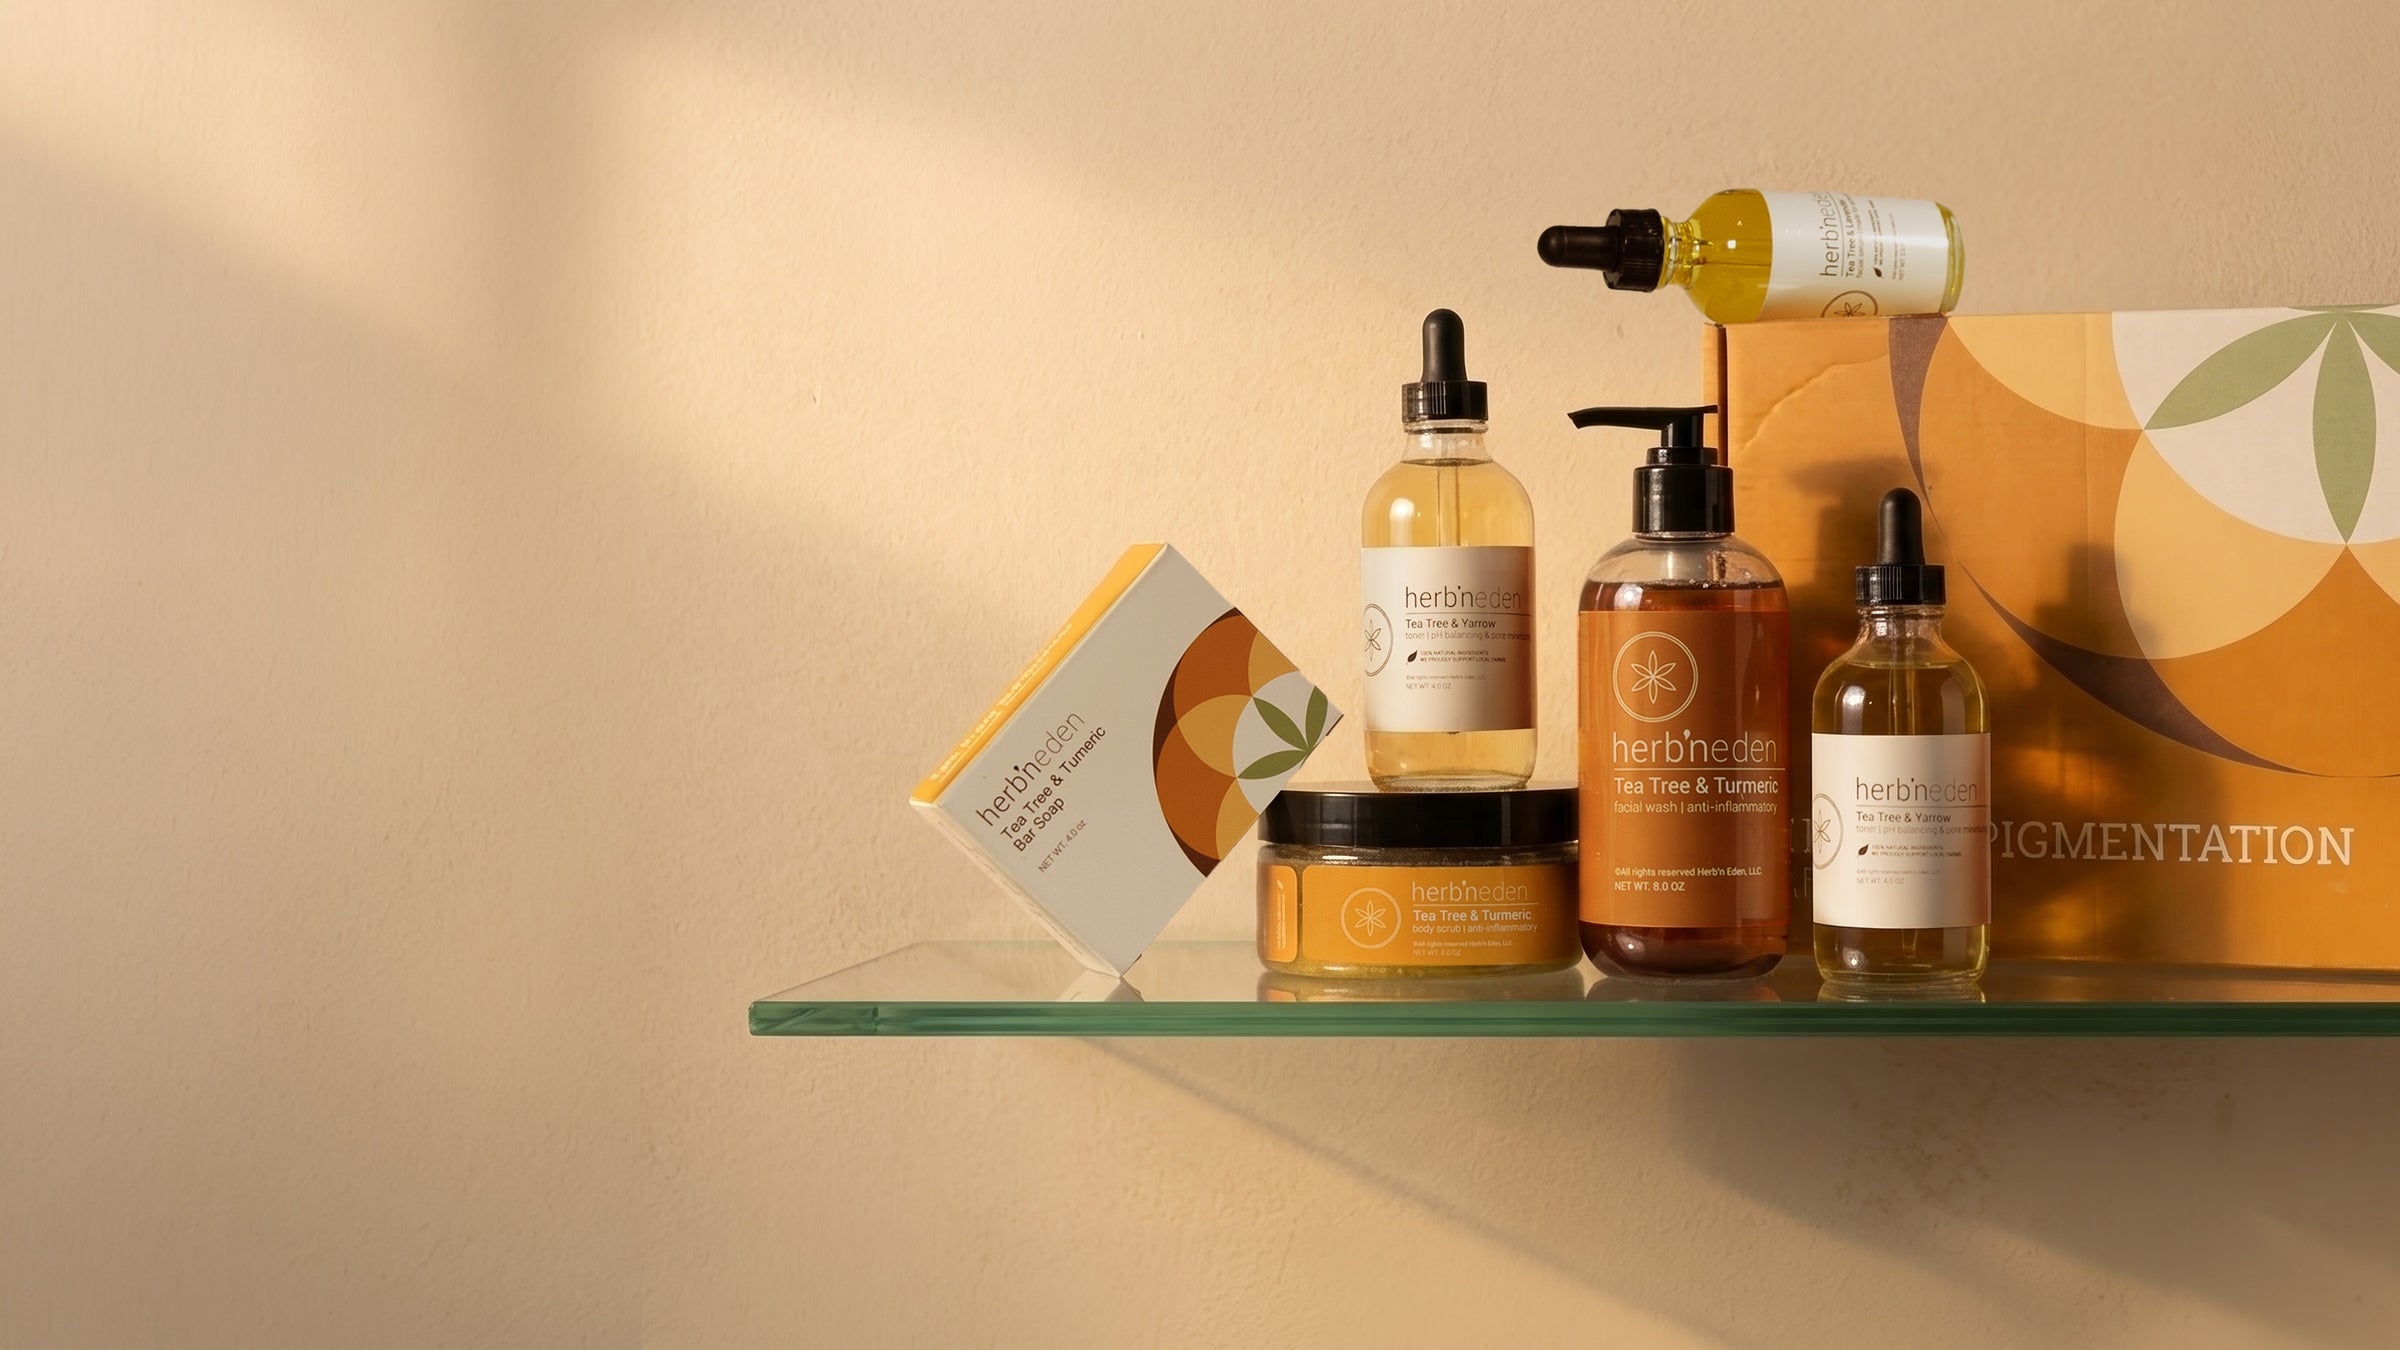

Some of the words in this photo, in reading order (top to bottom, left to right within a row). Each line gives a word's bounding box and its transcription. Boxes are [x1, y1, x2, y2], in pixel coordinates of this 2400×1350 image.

[1846, 238, 1856, 259] Tree
[1845, 261, 1855, 278] Tea
[1405, 618, 1423, 629] Tea
[1426, 618, 1449, 629] Tree
[1451, 618, 1459, 629] &
[1461, 618, 1496, 629] Yarrow
[1405, 631, 1425, 640] toner
[1431, 631, 1443, 641] pH
[1444, 631, 1483, 641] balancing
[1000, 815, 1027, 839] Tea
[1022, 786, 1053, 814] Tree
[1050, 774, 1064, 786] &
[1059, 726, 1106, 774] Tumeric
[1614, 777, 1644, 794] Tea
[1648, 777, 1691, 794] Tree
[1695, 776, 1709, 794] &
[1713, 776, 1779, 794] Turmeric
[1614, 800, 1643, 813] facial
[1645, 800, 1678, 813] wash
[1687, 800, 1777, 815] anti-inflammatory
[1856, 811, 1875, 822] Tea
[1877, 811, 1902, 822] Tree
[1904, 812, 1912, 823] &
[1914, 812, 1952, 823] Yarrow
[1013, 828, 1036, 852] Bar
[1033, 797, 1065, 829] Soap
[1856, 824, 1877, 833] toner
[1883, 824, 1896, 834] pH
[1897, 825, 1938, 836] balancing
[1038, 854, 1055, 872] NET
[1066, 828, 1078, 842] 4.0
[1076, 819, 1088, 831] oz
[1990, 820, 2355, 866] IGMENTATION
[1632, 867, 1656, 878] rights
[1657, 867, 1696, 877] reserved
[1697, 866, 1725, 876] Herb'n
[1726, 866, 1748, 877] Eden,
[1614, 881, 1632, 891] NET
[1633, 881, 1651, 891] WT.
[1652, 881, 1669, 891] 8.0
[1670, 881, 1686, 891] OZ
[1413, 909, 1436, 921] Tea
[1440, 909, 1468, 921] Tree
[1470, 909, 1479, 921] &
[1481, 908, 1532, 921] Turmeric
[1412, 924, 1435, 935] body
[1436, 924, 1462, 933] scrub
[1467, 923, 1538, 934] anti-inflammatory
